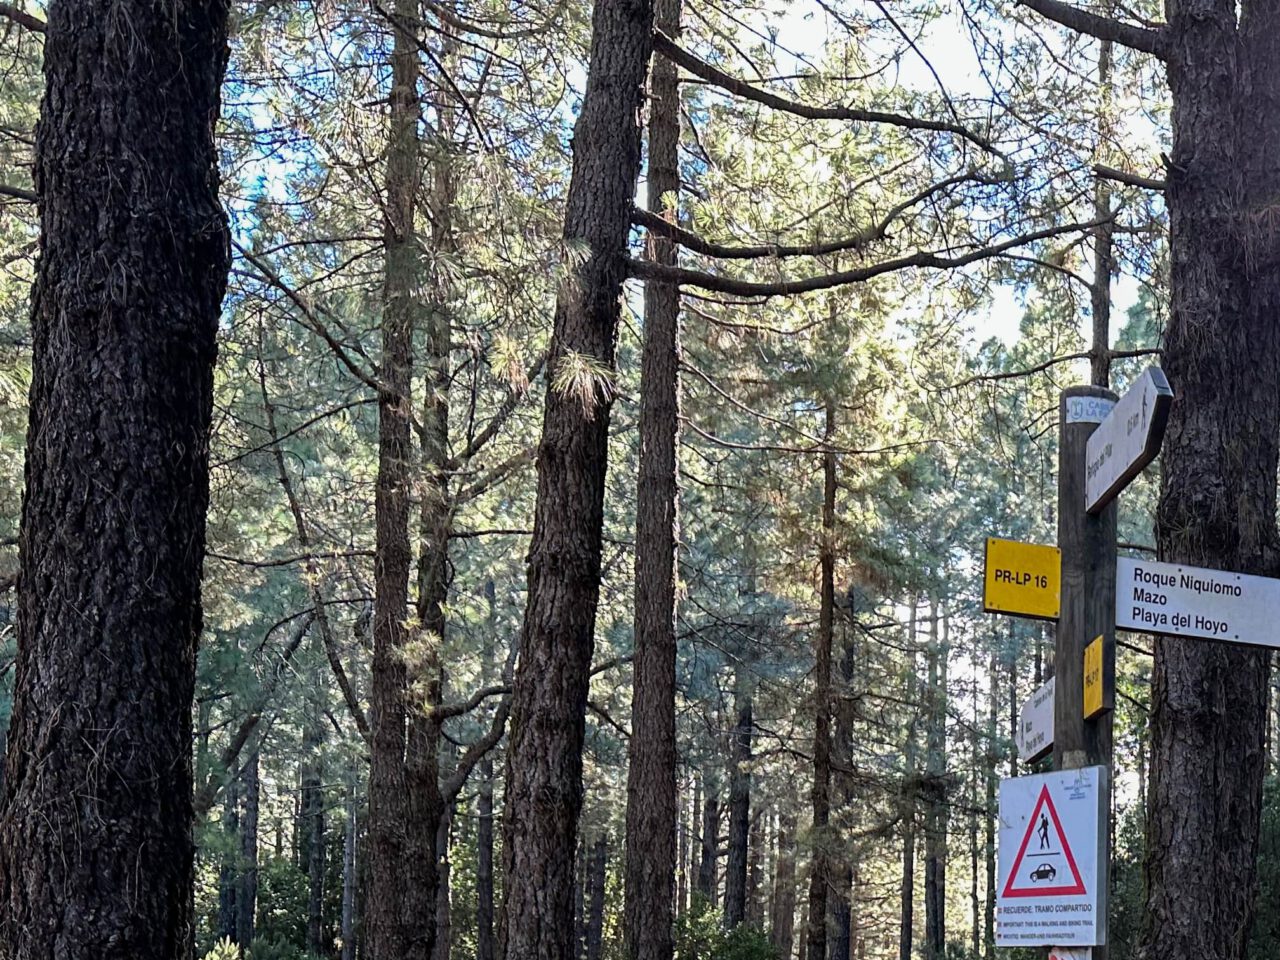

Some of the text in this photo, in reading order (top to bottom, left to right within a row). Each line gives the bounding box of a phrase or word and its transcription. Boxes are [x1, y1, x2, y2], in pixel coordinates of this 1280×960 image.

[994, 568, 1048, 589] PR-LP 16
[1133, 567, 1176, 588] Roque
[1180, 574, 1242, 597] Niquiomo
[1133, 587, 1167, 606] Mazo
[1132, 606, 1168, 627] Playa
[1171, 612, 1191, 628] del
[1195, 615, 1228, 635] Hoyo
[1035, 904, 1054, 912] TRAMO
[1055, 903, 1092, 912] COMPARTIDO
